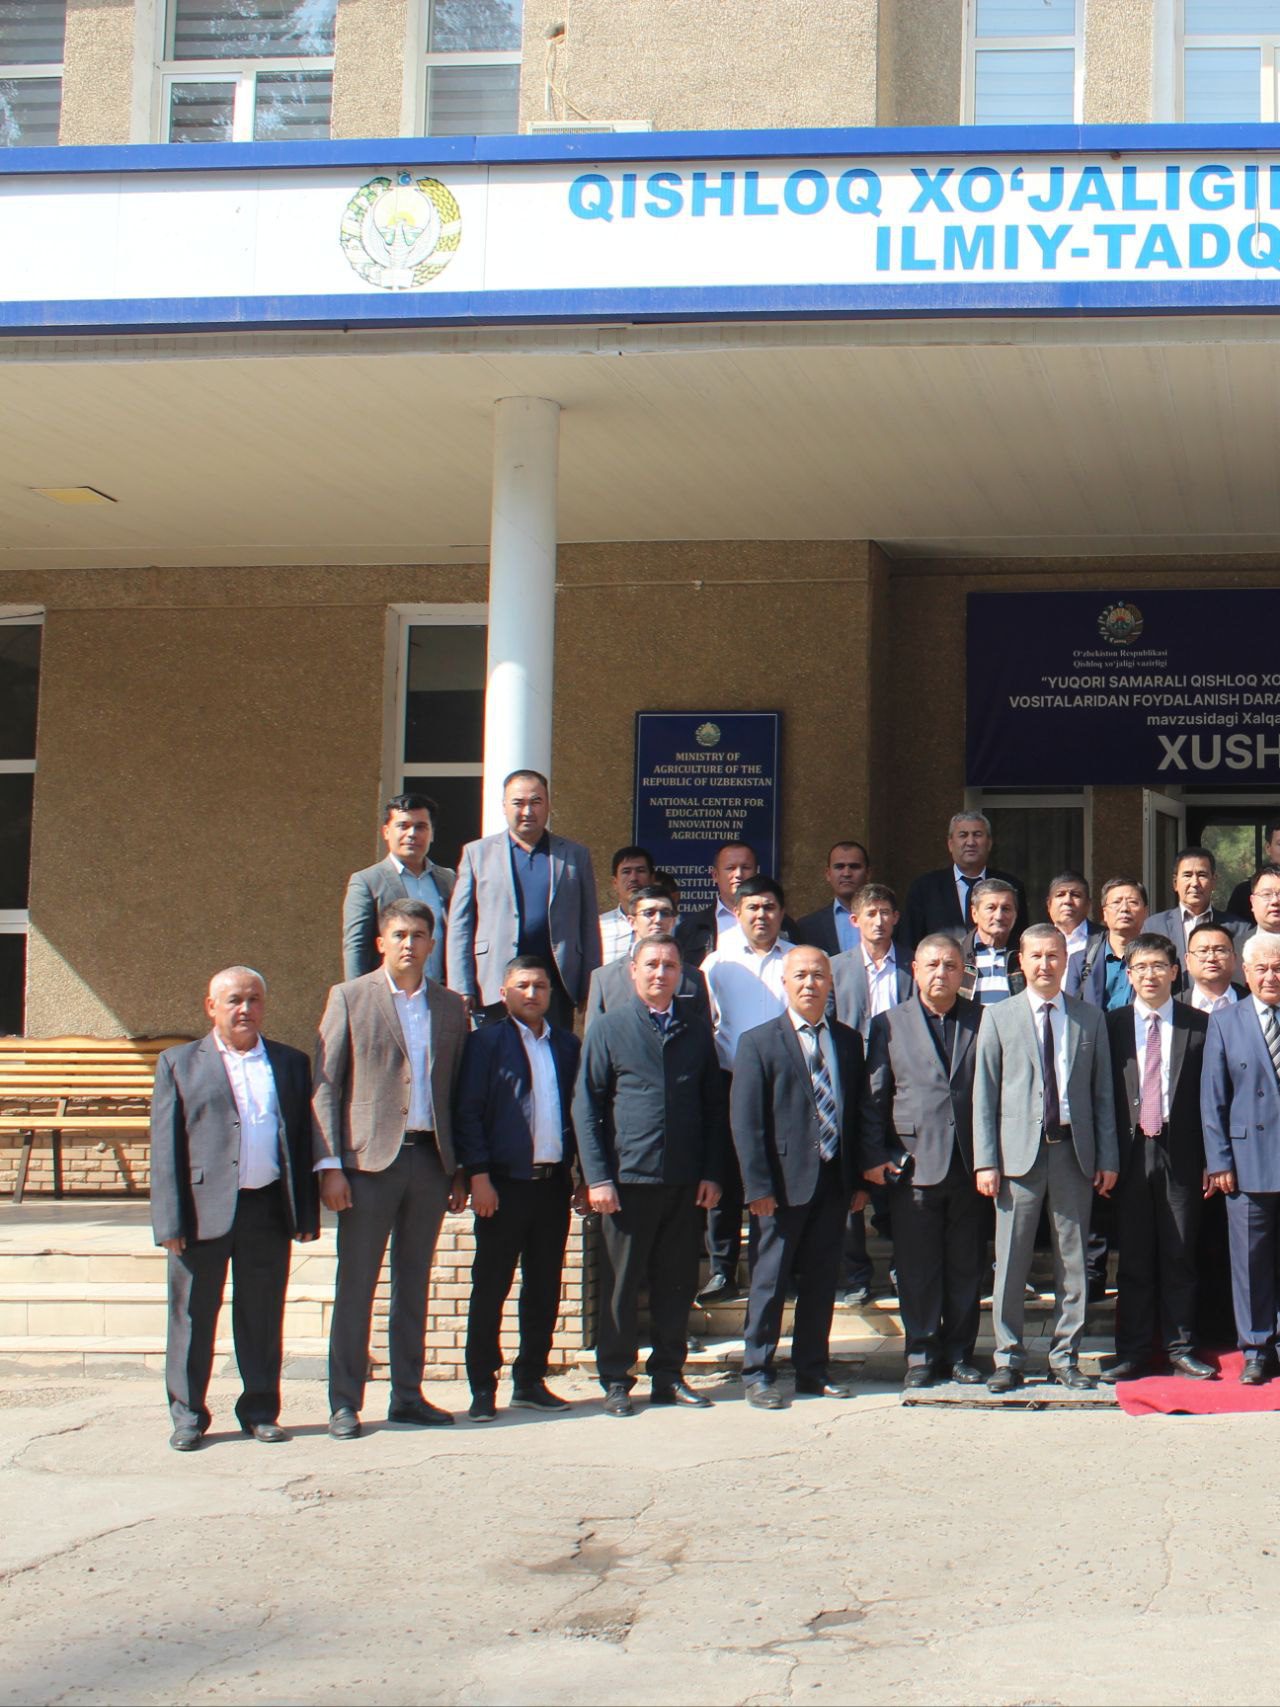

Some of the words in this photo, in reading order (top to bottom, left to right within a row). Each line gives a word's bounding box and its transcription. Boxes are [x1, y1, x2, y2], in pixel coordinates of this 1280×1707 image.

[568, 168, 882, 221] QISHLOQ
[1120, 649, 1168, 658] Respublikasi
[1073, 660, 1103, 668] Qishloq
[1137, 659, 1167, 668] vazirligi
[1109, 675, 1186, 688] SAMARALI
[1190, 674, 1257, 688] QISHLOQ
[1009, 695, 1128, 708] VOSITALARIDAN
[1133, 693, 1239, 707] FOYDALANISH
[1147, 711, 1238, 727] mavzusidagi
[676, 753, 724, 761] MINISTRY
[727, 753, 740, 761] OF
[653, 765, 723, 774] AGRICULTURE
[725, 765, 739, 774] OF
[741, 765, 762, 774] THE
[643, 778, 692, 786] REPUBLIC
[694, 778, 707, 786] OF
[710, 778, 772, 787] UZBEKISTAN
[650, 798, 700, 806] NATIONAL
[702, 798, 741, 806] CENTER
[744, 798, 764, 807] FOR
[665, 809, 723, 817] EDUCATION
[725, 809, 747, 818] AND
[668, 820, 730, 829] INNOVATION
[732, 820, 743, 829] IN
[671, 831, 740, 840] AGRICULTURE
